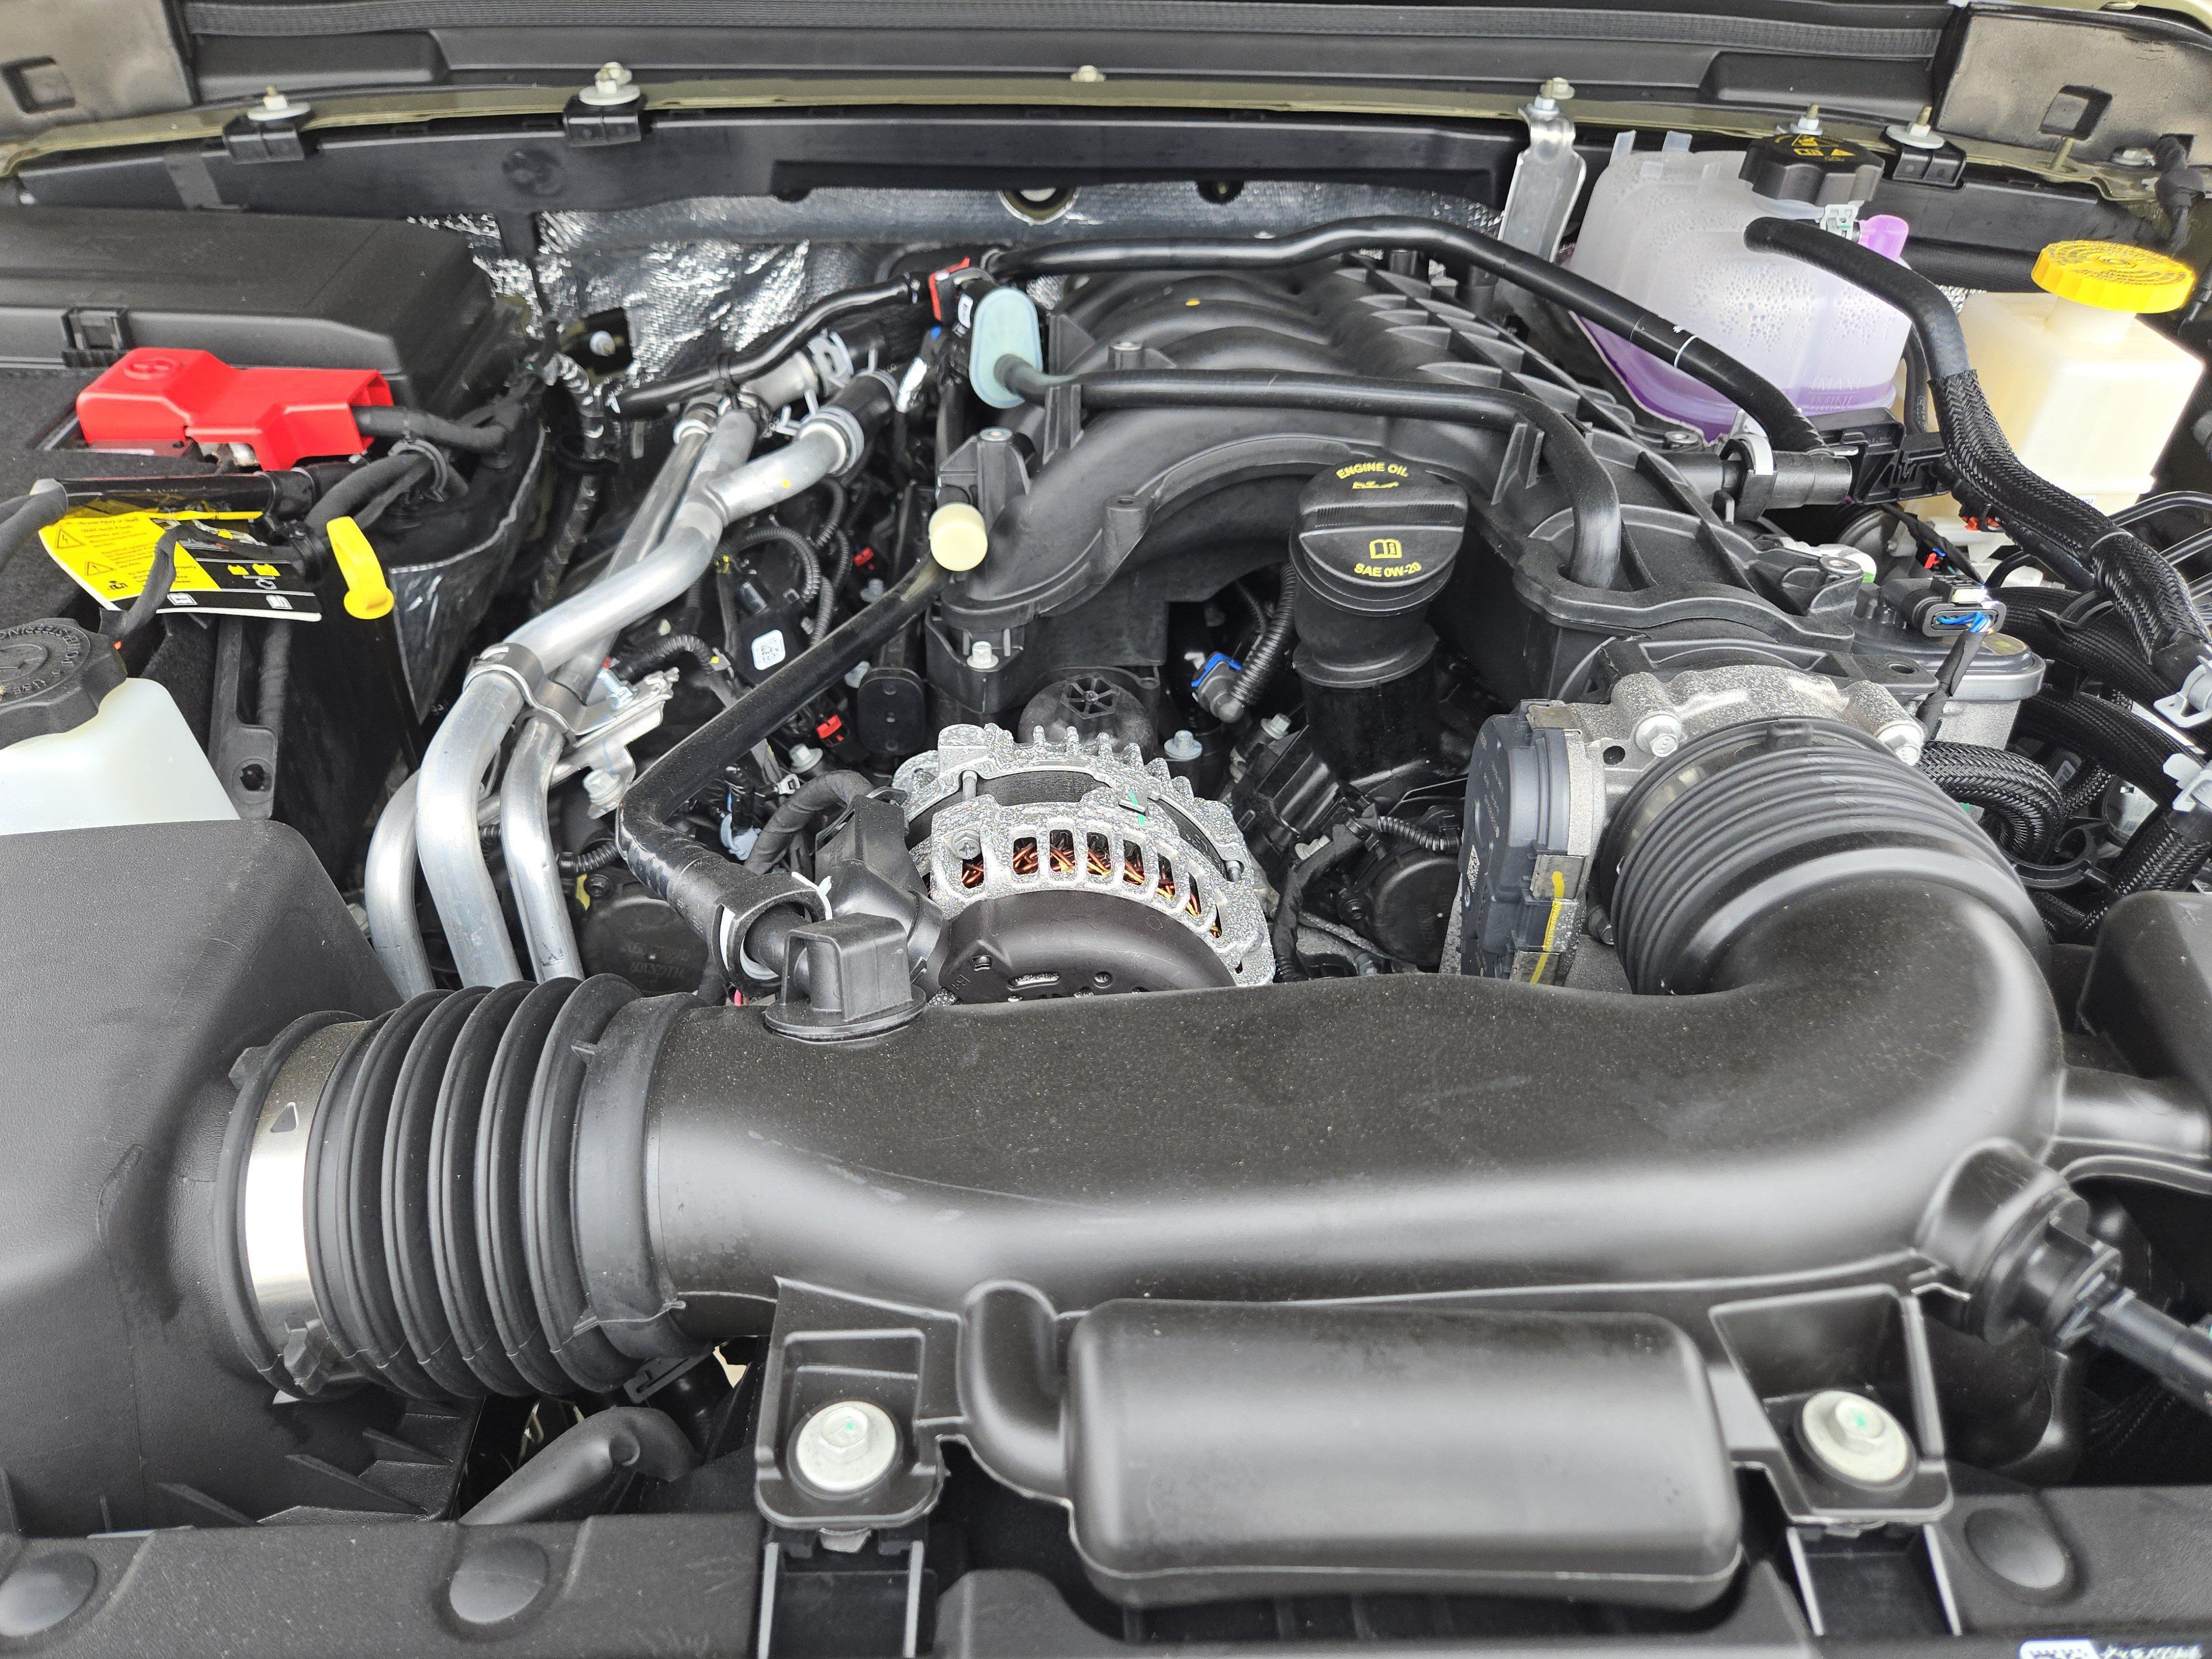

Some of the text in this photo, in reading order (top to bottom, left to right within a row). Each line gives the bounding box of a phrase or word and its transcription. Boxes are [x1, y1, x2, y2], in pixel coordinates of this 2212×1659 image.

[1336, 462, 1408, 479] ENGINE OIL
[1354, 561, 1422, 577] SAE 0W-20
